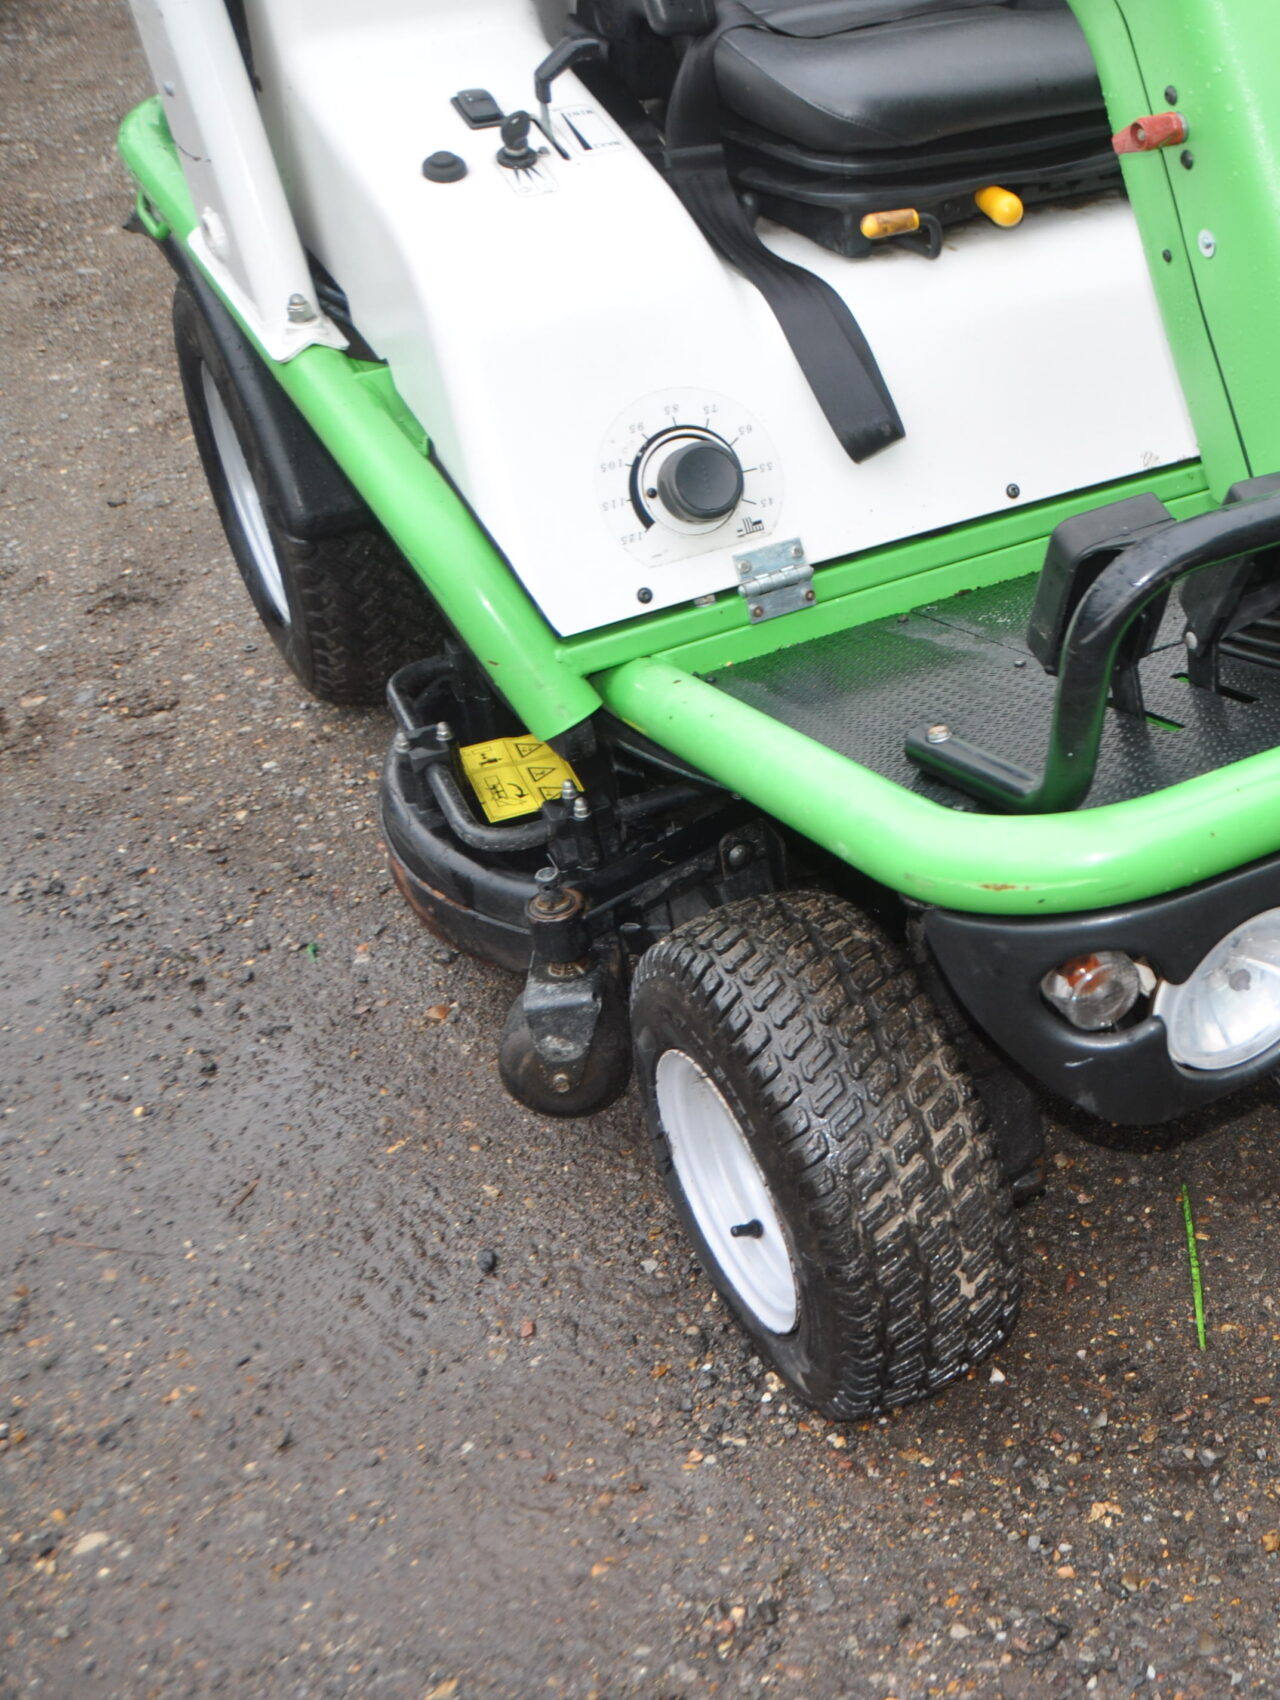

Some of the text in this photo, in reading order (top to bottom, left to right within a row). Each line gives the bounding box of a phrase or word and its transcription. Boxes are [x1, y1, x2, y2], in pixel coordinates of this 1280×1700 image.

[737, 423, 752, 436] 65
[600, 458, 623, 473] 105
[602, 496, 625, 511] 115
[620, 531, 643, 545] 125
